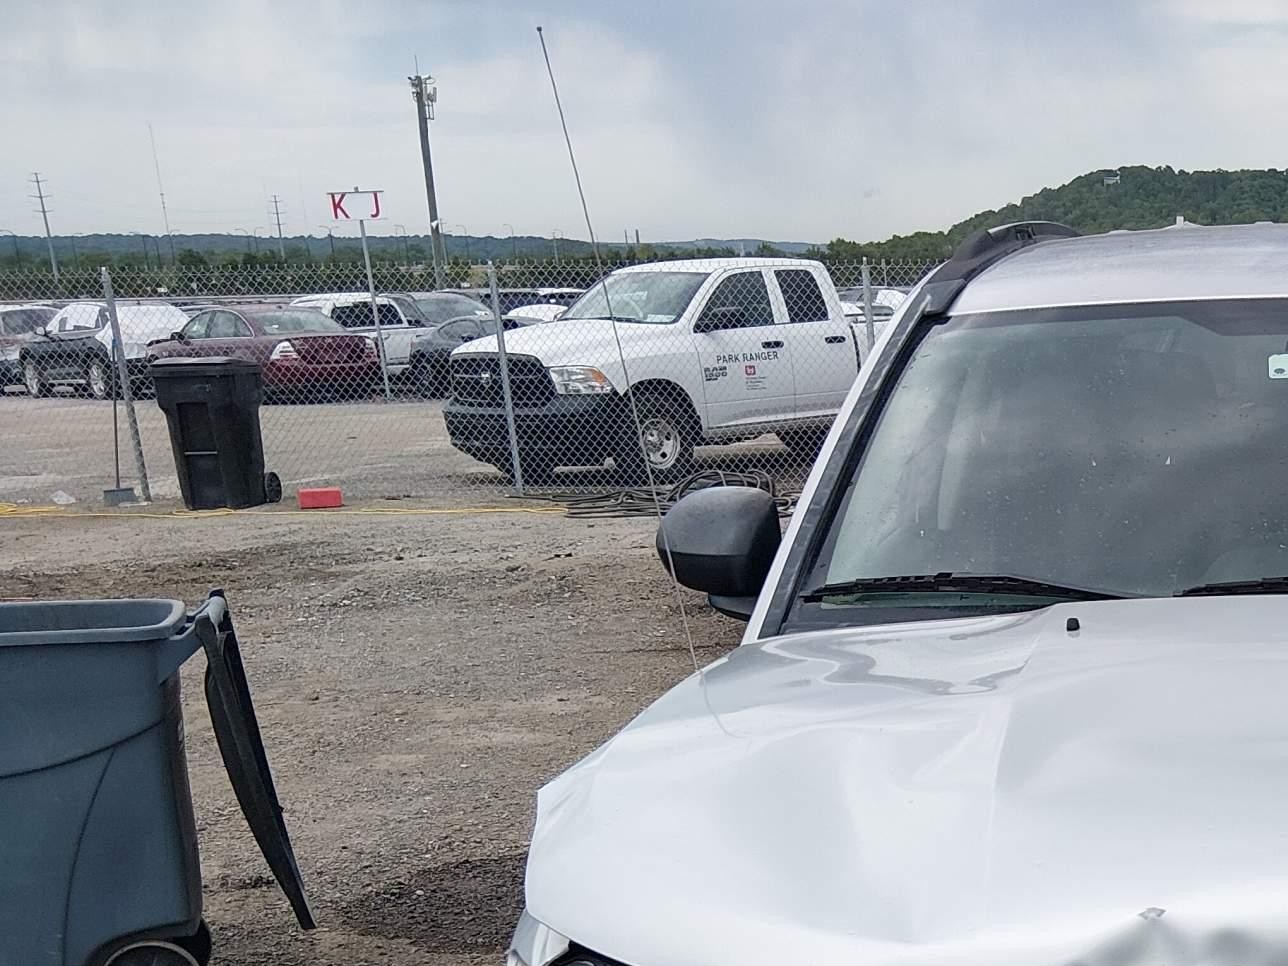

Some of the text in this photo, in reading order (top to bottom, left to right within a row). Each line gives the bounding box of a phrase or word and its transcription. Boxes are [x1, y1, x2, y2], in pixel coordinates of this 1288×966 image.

[330, 192, 380, 219] K J
[716, 351, 779, 364] PARK RANGER
